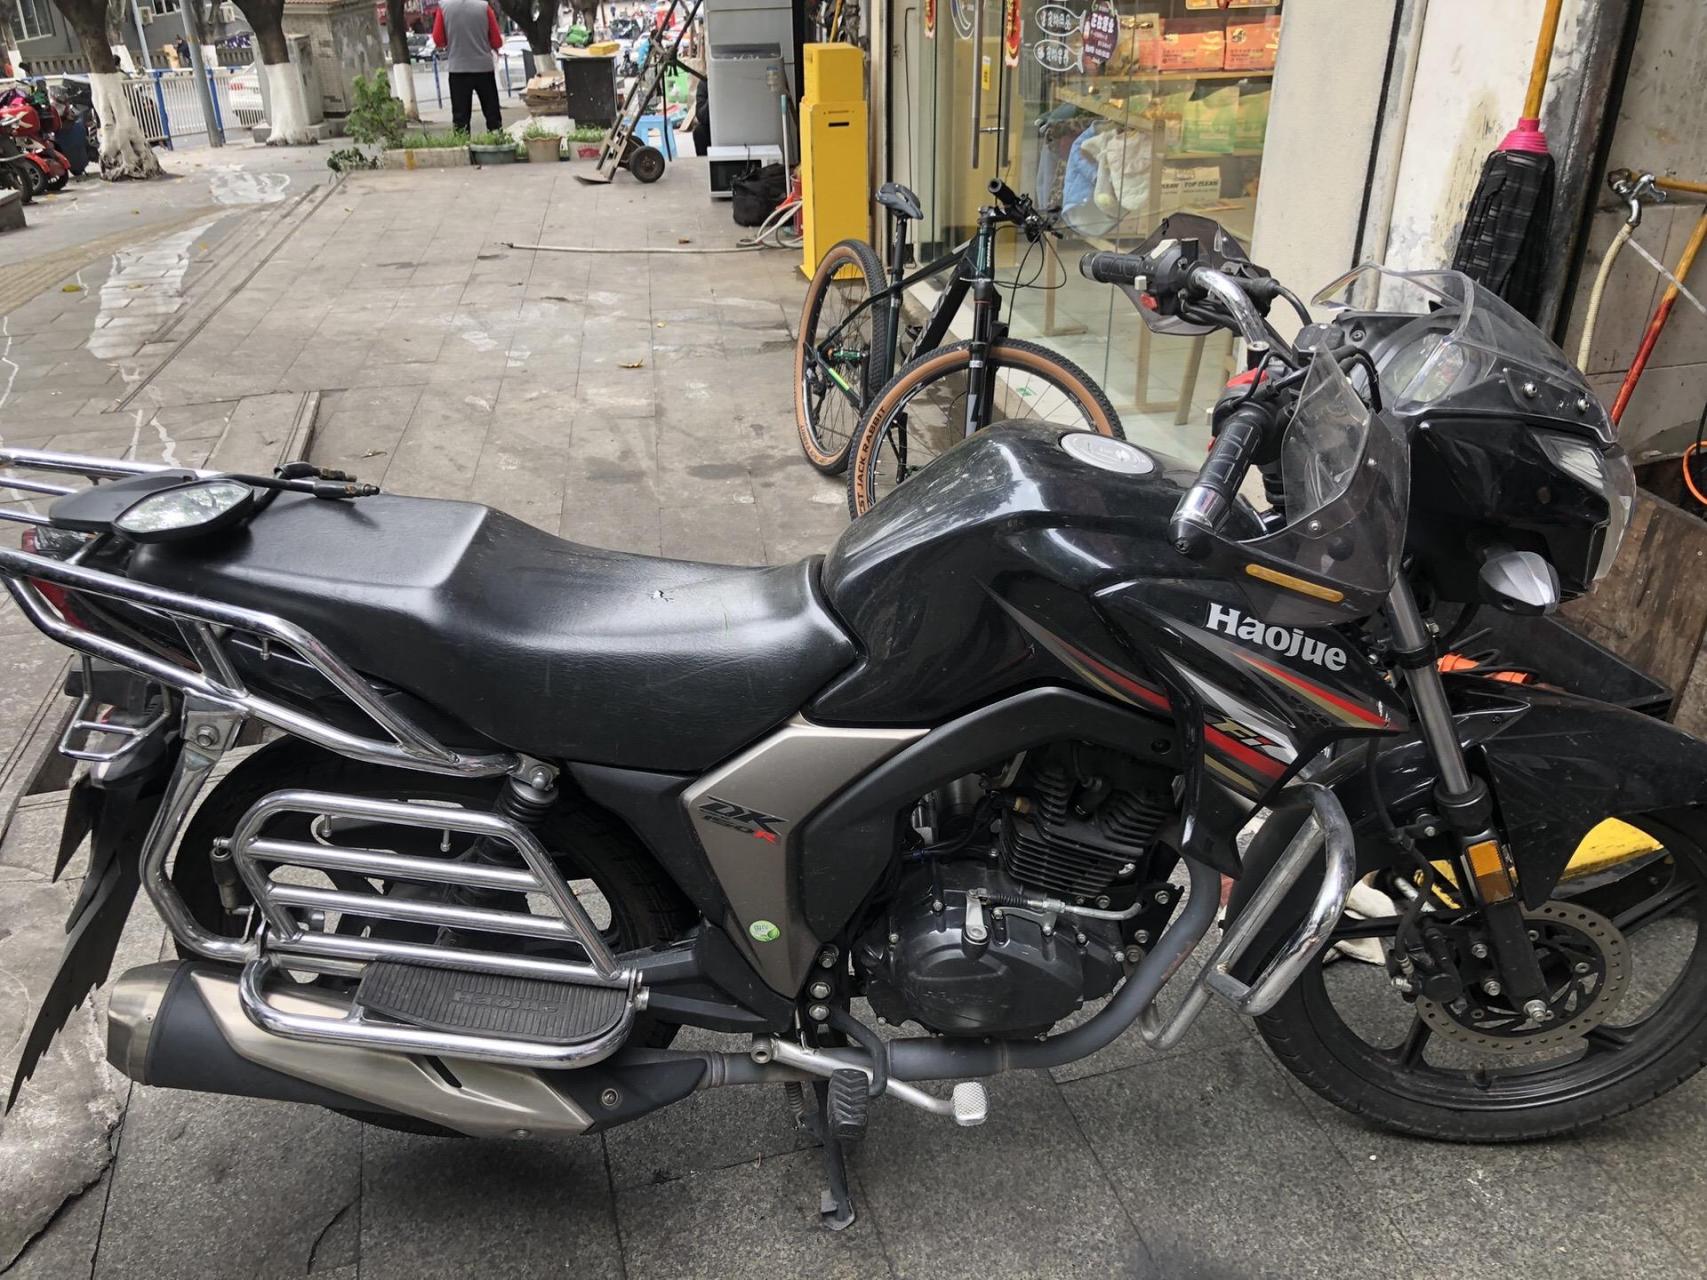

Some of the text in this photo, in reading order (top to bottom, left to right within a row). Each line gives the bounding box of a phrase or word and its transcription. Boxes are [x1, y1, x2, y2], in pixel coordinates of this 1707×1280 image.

[857, 457, 866, 488] JACK
[862, 406, 886, 452] RABBIT
[1206, 602, 1347, 671] Haojue
[698, 795, 790, 837] DK
